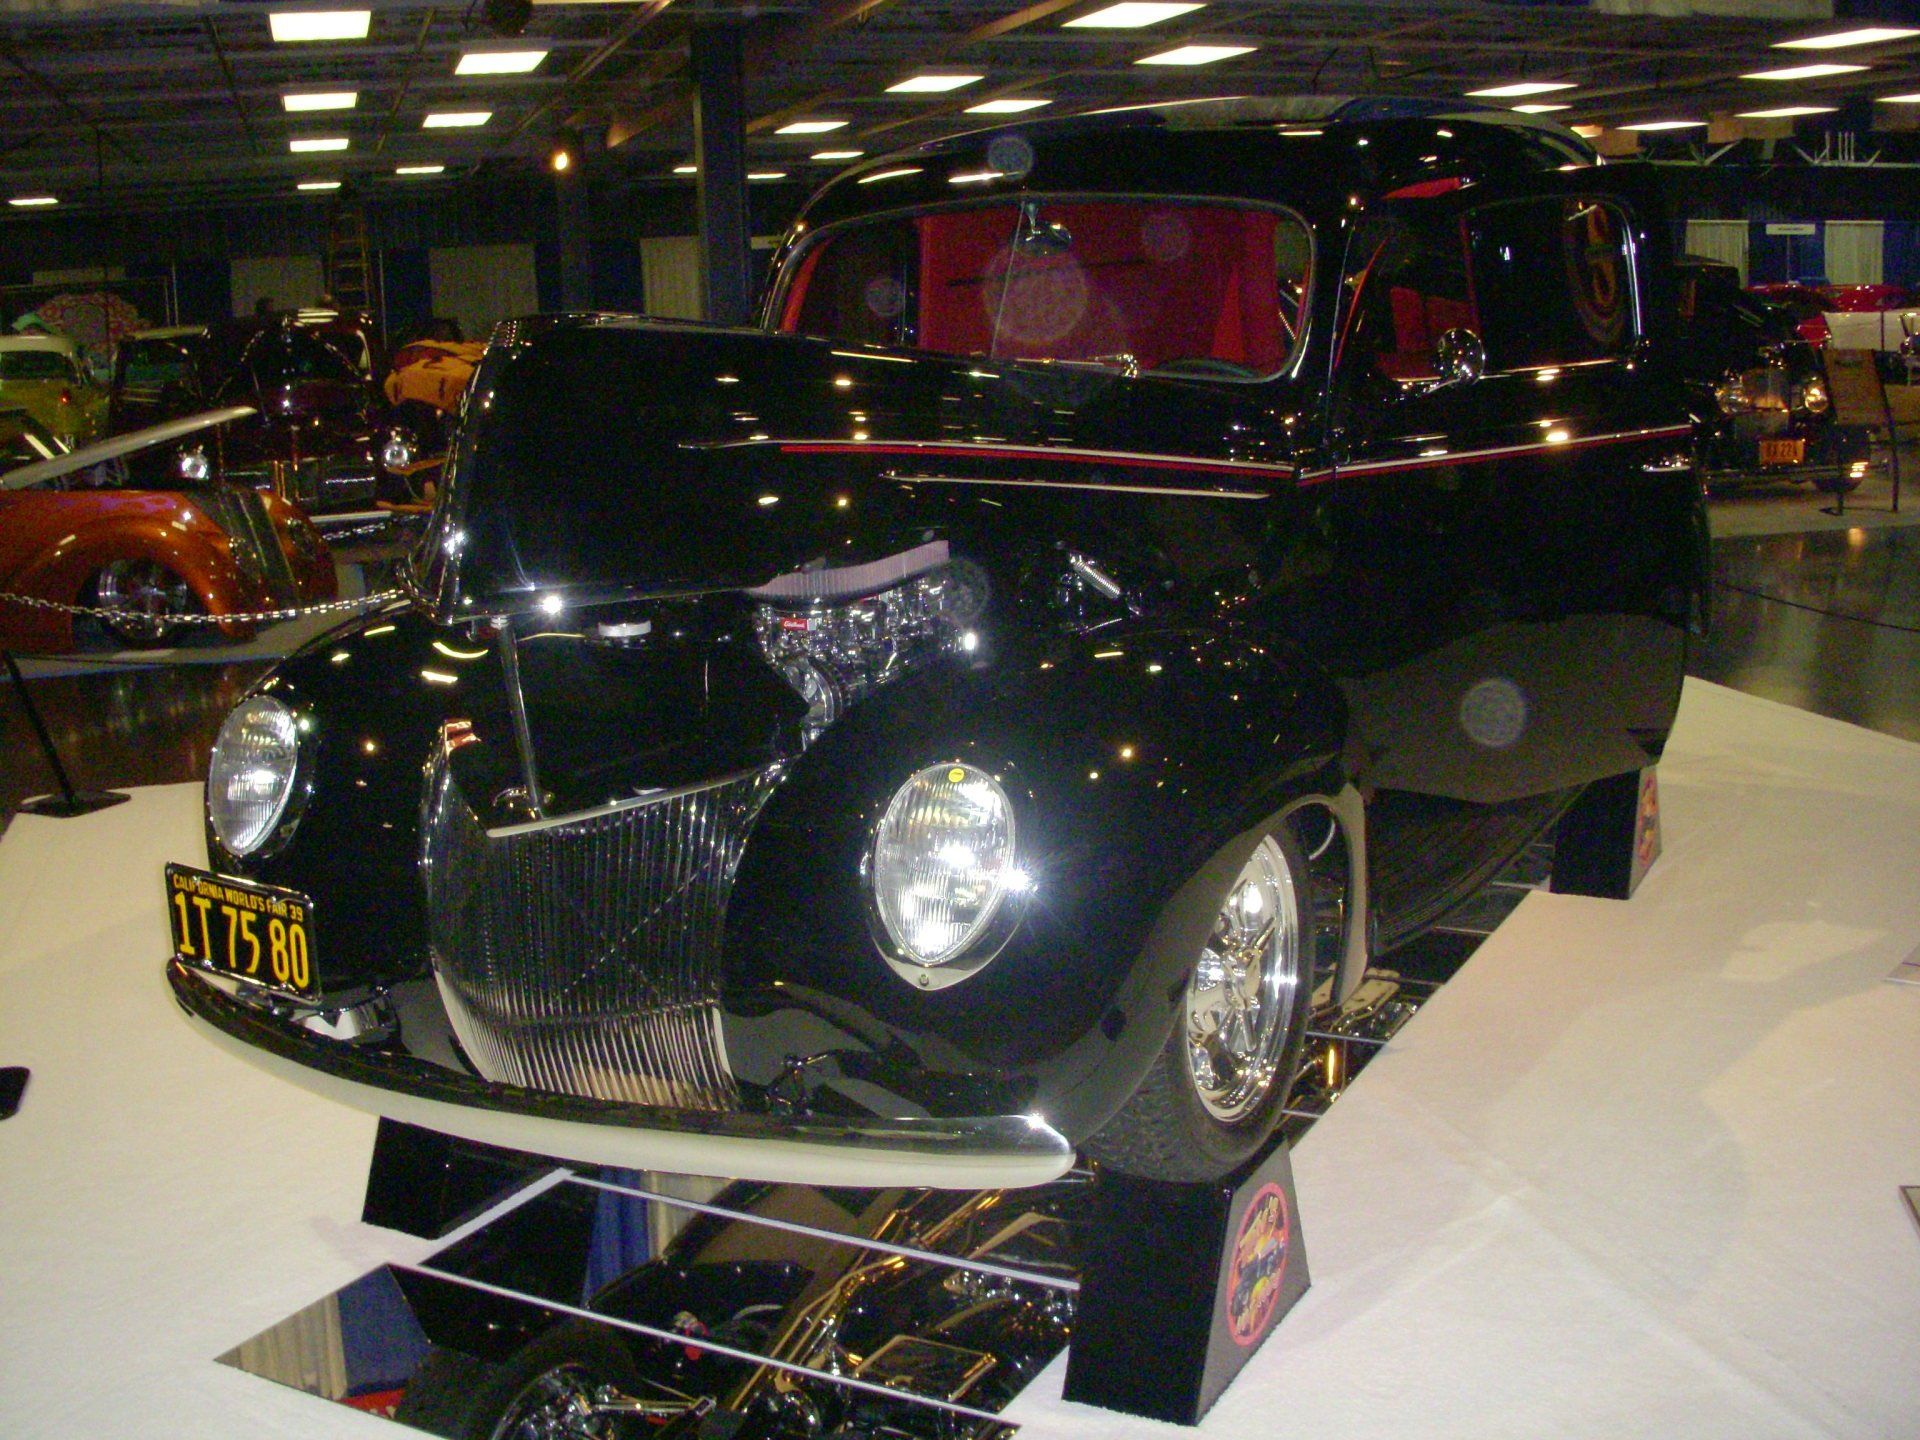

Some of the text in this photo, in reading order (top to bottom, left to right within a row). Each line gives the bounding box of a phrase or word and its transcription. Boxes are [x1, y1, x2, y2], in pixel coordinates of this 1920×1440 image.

[173, 874, 304, 922] CALIFORNIA WORLD'S FAIR 39
